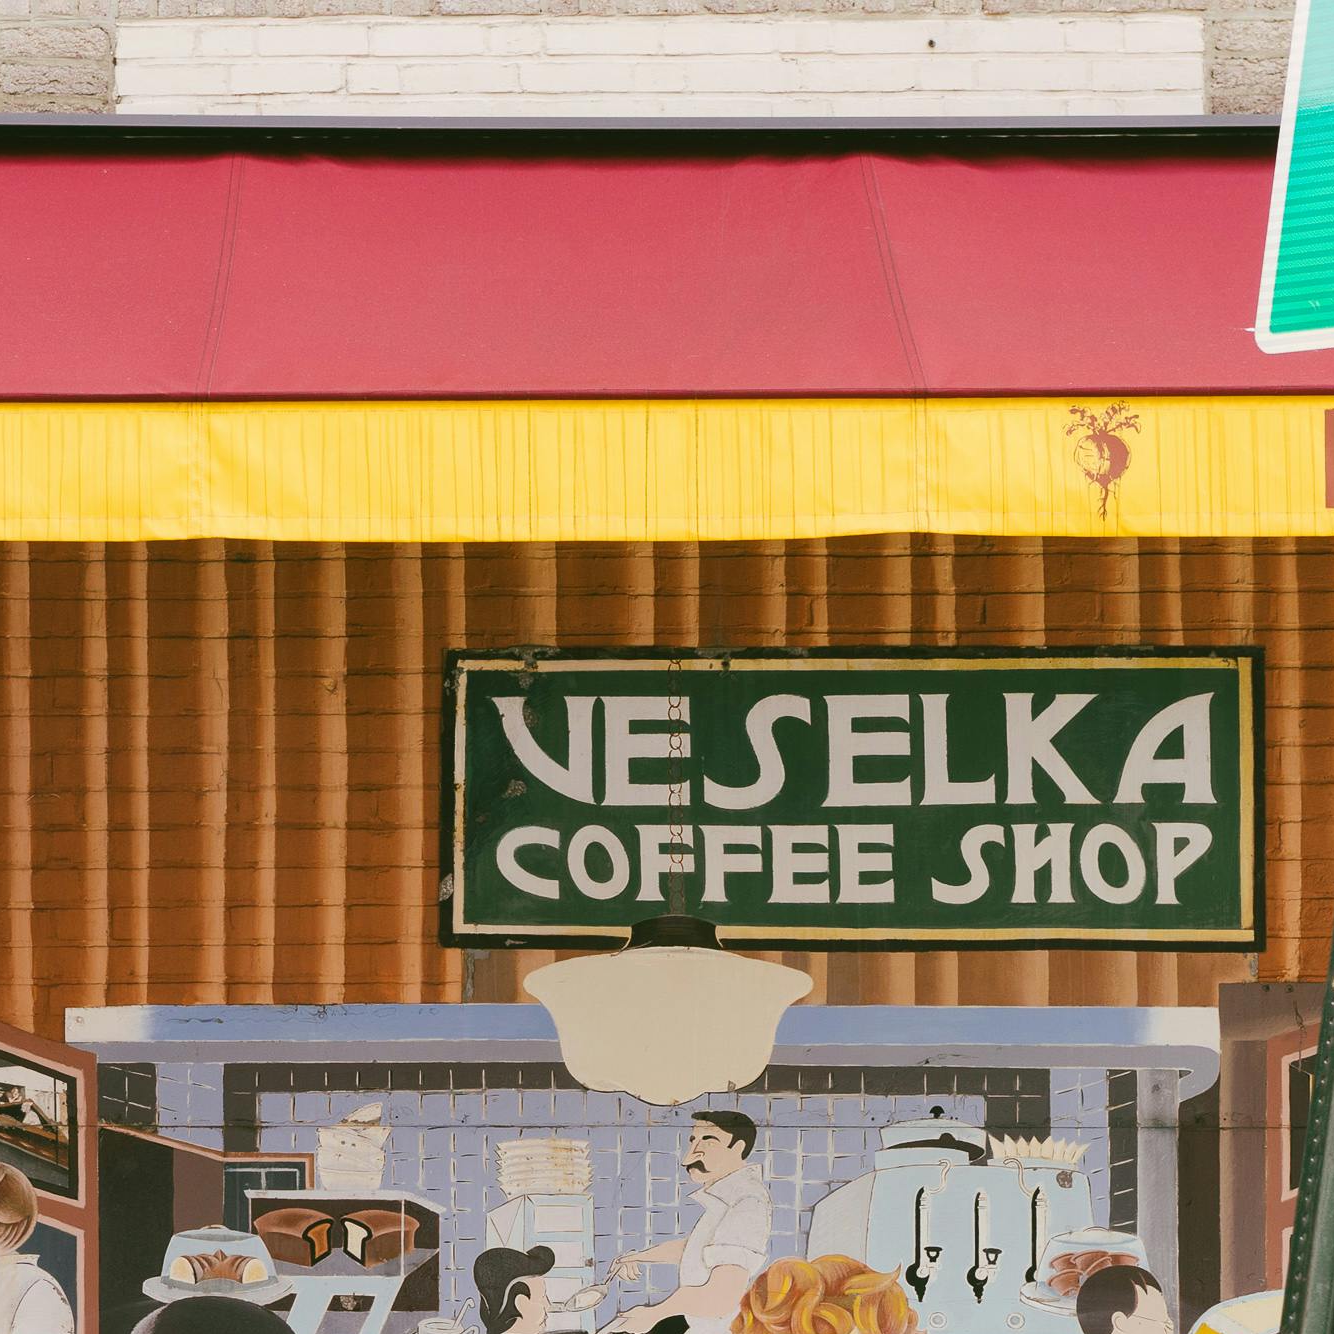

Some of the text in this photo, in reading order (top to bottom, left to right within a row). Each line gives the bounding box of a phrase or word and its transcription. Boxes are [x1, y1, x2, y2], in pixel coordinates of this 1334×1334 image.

[487, 691, 1219, 810] VESELKA
[495, 822, 1215, 906] COFFEE SHOP
